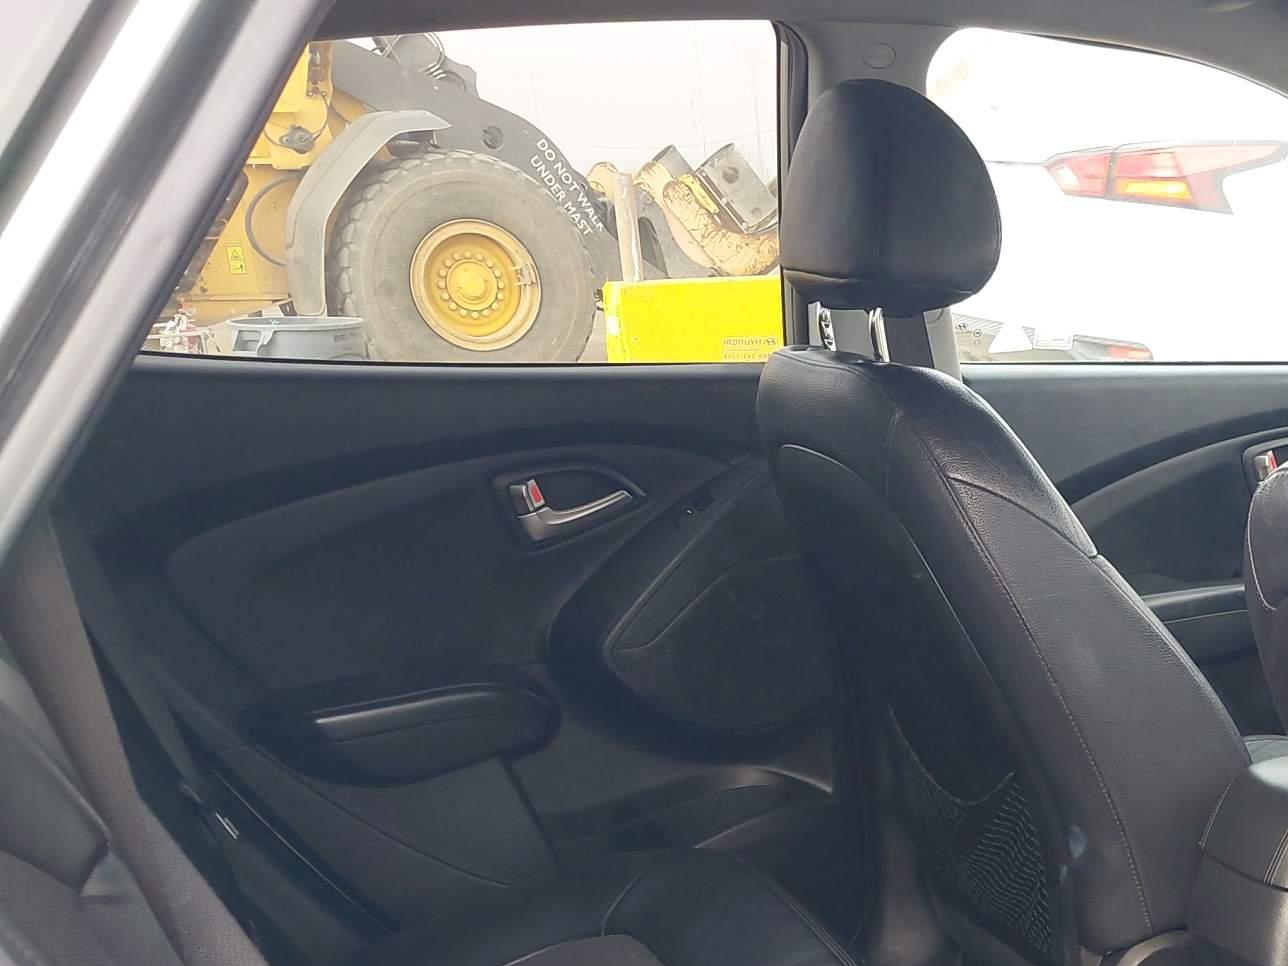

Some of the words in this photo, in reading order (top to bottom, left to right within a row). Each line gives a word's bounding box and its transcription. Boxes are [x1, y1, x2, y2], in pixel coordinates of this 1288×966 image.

[530, 155, 566, 203] UNDER
[563, 201, 594, 236] MAST
[536, 138, 556, 161] DO
[553, 162, 580, 192] NOT
[577, 192, 605, 232] WALK
